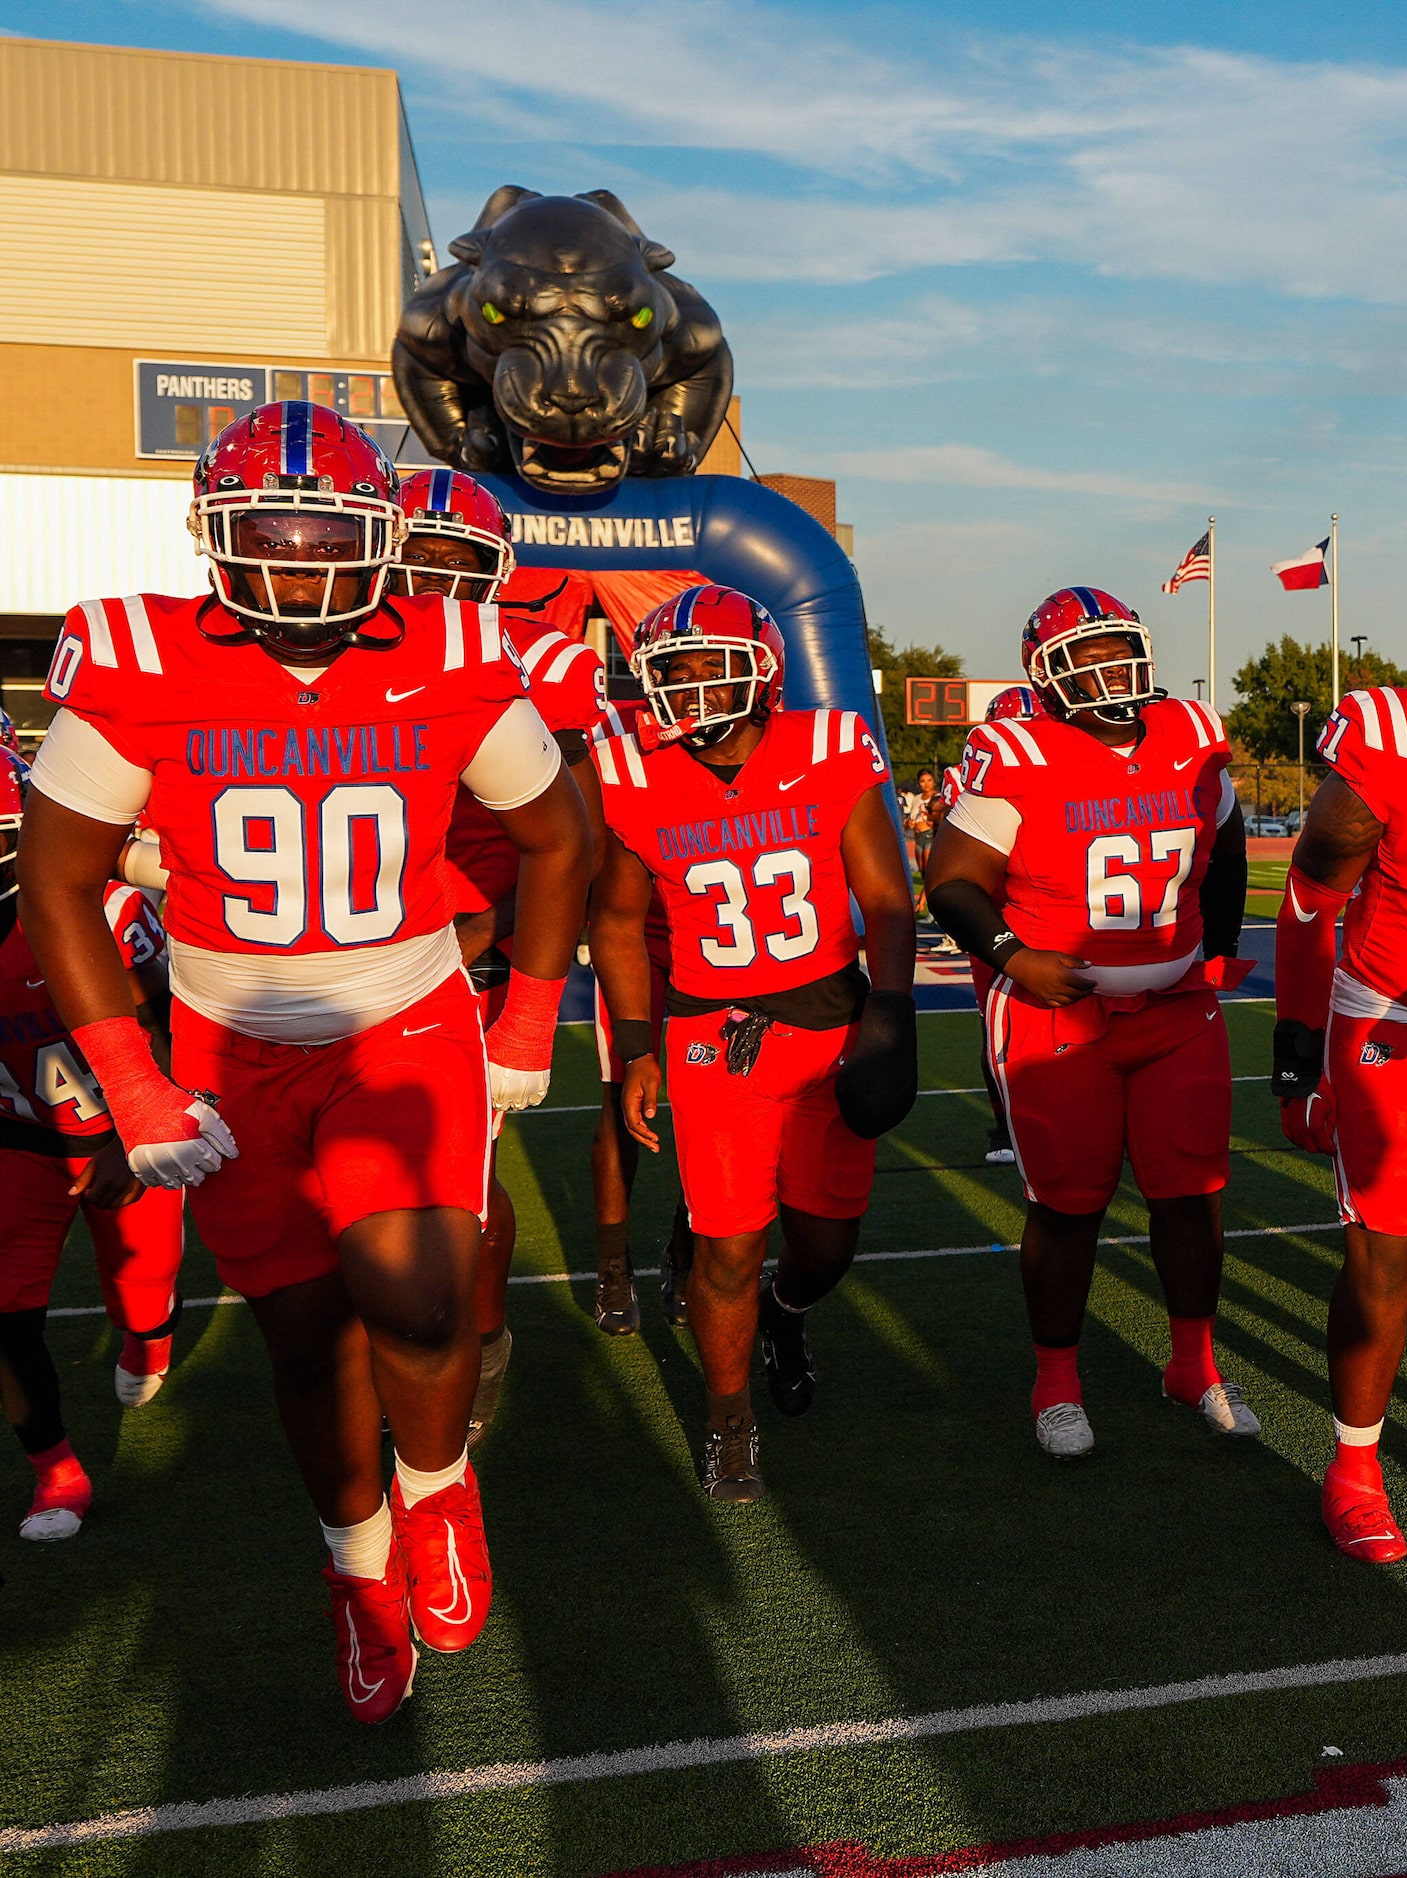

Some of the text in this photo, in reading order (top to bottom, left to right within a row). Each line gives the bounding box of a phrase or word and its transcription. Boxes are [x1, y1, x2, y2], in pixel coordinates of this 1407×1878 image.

[156, 374, 254, 401] PANTHERS
[505, 512, 695, 548] UNCANVILLE
[41, 626, 84, 700] 0
[502, 627, 531, 691] 9
[914, 682, 966, 720] 25
[186, 724, 431, 777] DUNCANVILLE
[861, 733, 885, 773] 3
[961, 742, 994, 793] 67
[656, 804, 820, 860] DUNCANVILLE
[1065, 786, 1206, 833] DUNCANVILLE
[211, 782, 409, 948] 90
[1087, 827, 1197, 930] 67
[684, 848, 820, 968] 33
